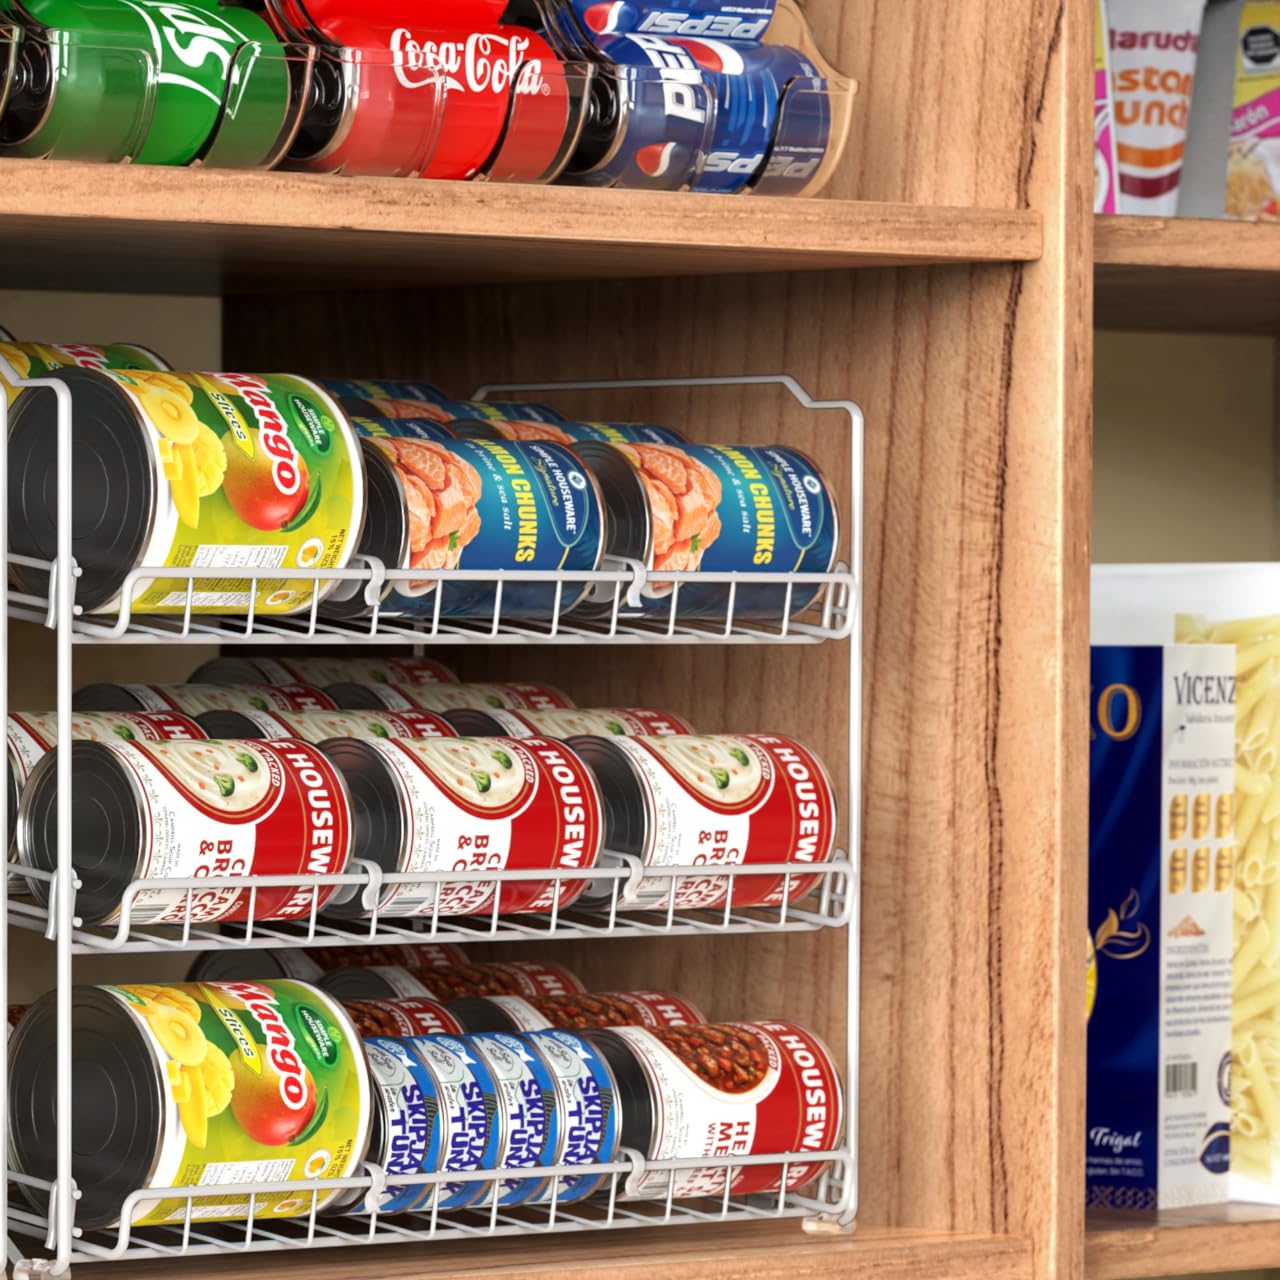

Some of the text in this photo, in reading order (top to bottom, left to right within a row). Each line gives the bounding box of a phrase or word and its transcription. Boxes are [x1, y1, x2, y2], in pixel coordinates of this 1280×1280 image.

[638, 10, 770, 39] PEPSI
[211, 392, 247, 440] Slices
[213, 372, 297, 491] Mango
[295, 399, 322, 446] HOUSEWARE
[307, 408, 325, 436] SIMPLE
[496, 484, 508, 501] sea
[553, 472, 576, 533] HOUSEWARE
[735, 489, 752, 534] sea salt
[790, 476, 812, 536] HOUSEWARE
[510, 479, 538, 564] CHUNKS
[749, 482, 773, 565] CHUNKS
[199, 840, 214, 856] &
[458, 835, 472, 850] &
[699, 830, 712, 845] &
[218, 1009, 255, 1058] Slices
[220, 982, 304, 1105] Mango
[301, 1010, 330, 1058] HOUSEWARE
[314, 1019, 332, 1047] SIMPLE
[1089, 1126, 1143, 1153] Trigal
